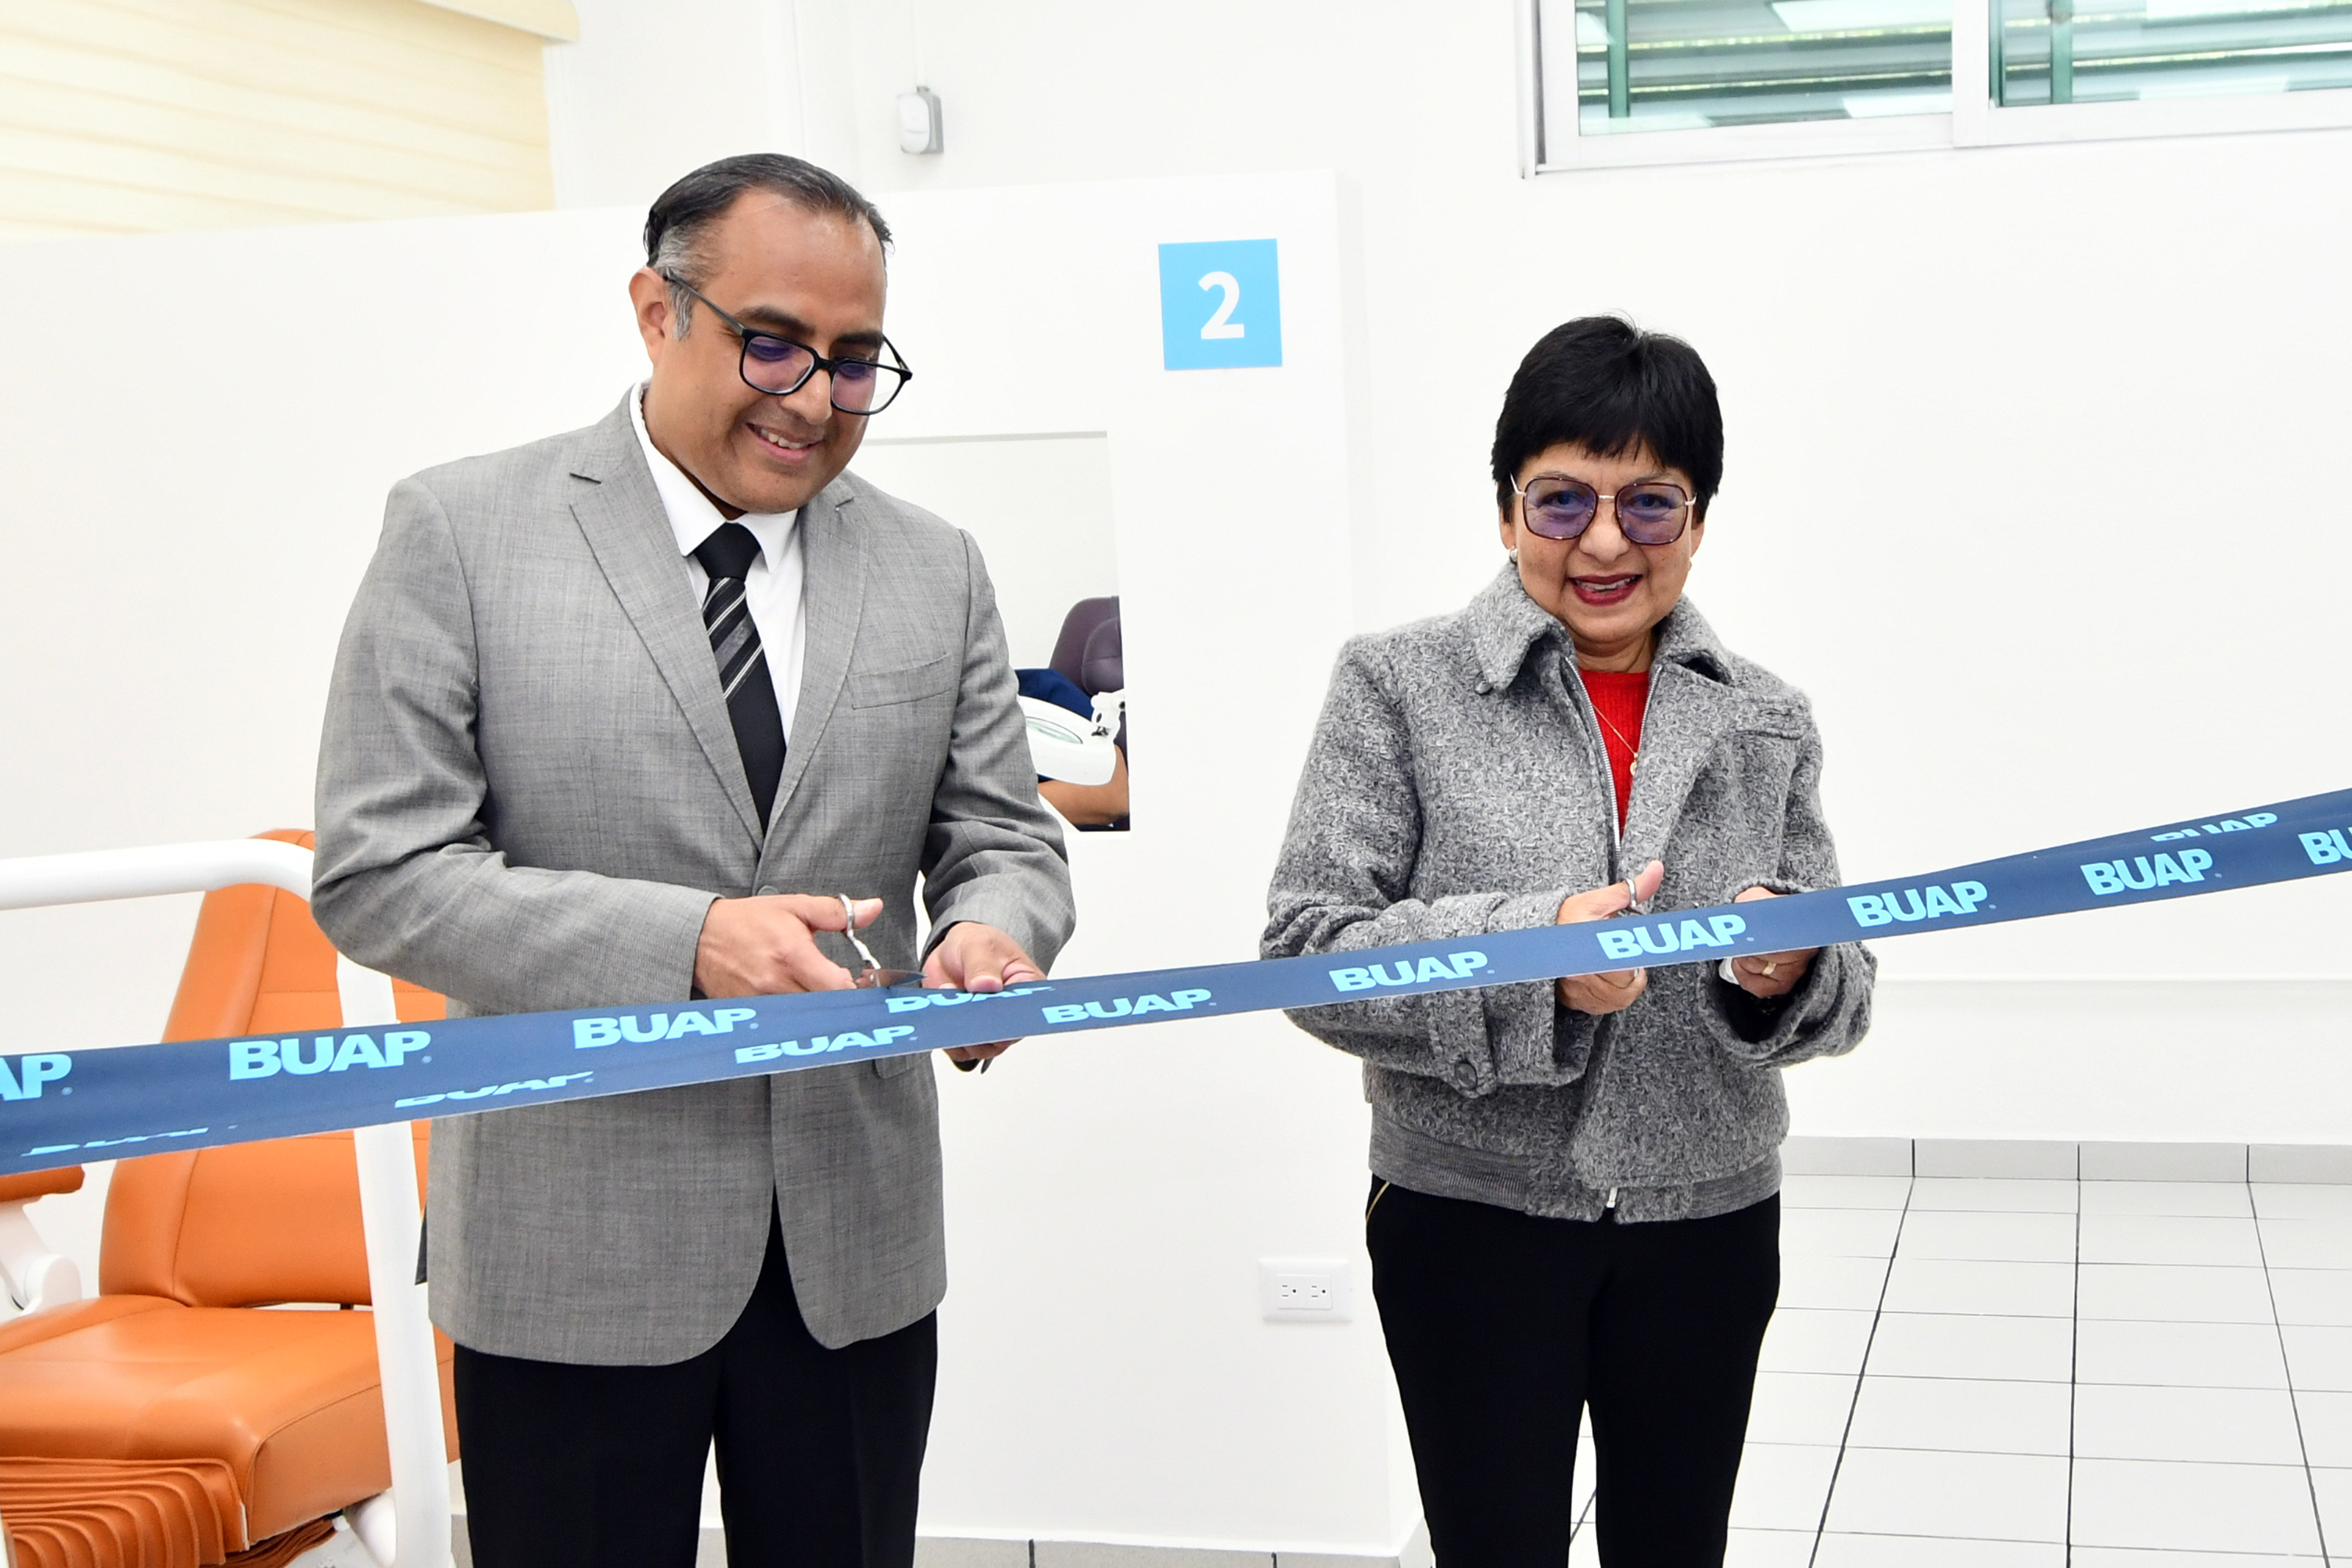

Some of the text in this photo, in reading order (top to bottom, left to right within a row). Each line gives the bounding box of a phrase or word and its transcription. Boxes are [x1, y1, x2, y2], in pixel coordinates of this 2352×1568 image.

[1198, 271, 1245, 340] 2
[2080, 849, 2213, 896] BUAP
[1846, 880, 1988, 928] BUAP
[1596, 914, 1747, 960] BUAP
[1329, 951, 1489, 992] BUAP
[573, 1008, 757, 1050] BUAP
[1041, 988, 1212, 1025] BUAP
[228, 1030, 431, 1081] BUAP
[735, 1025, 915, 1064] BUAP
